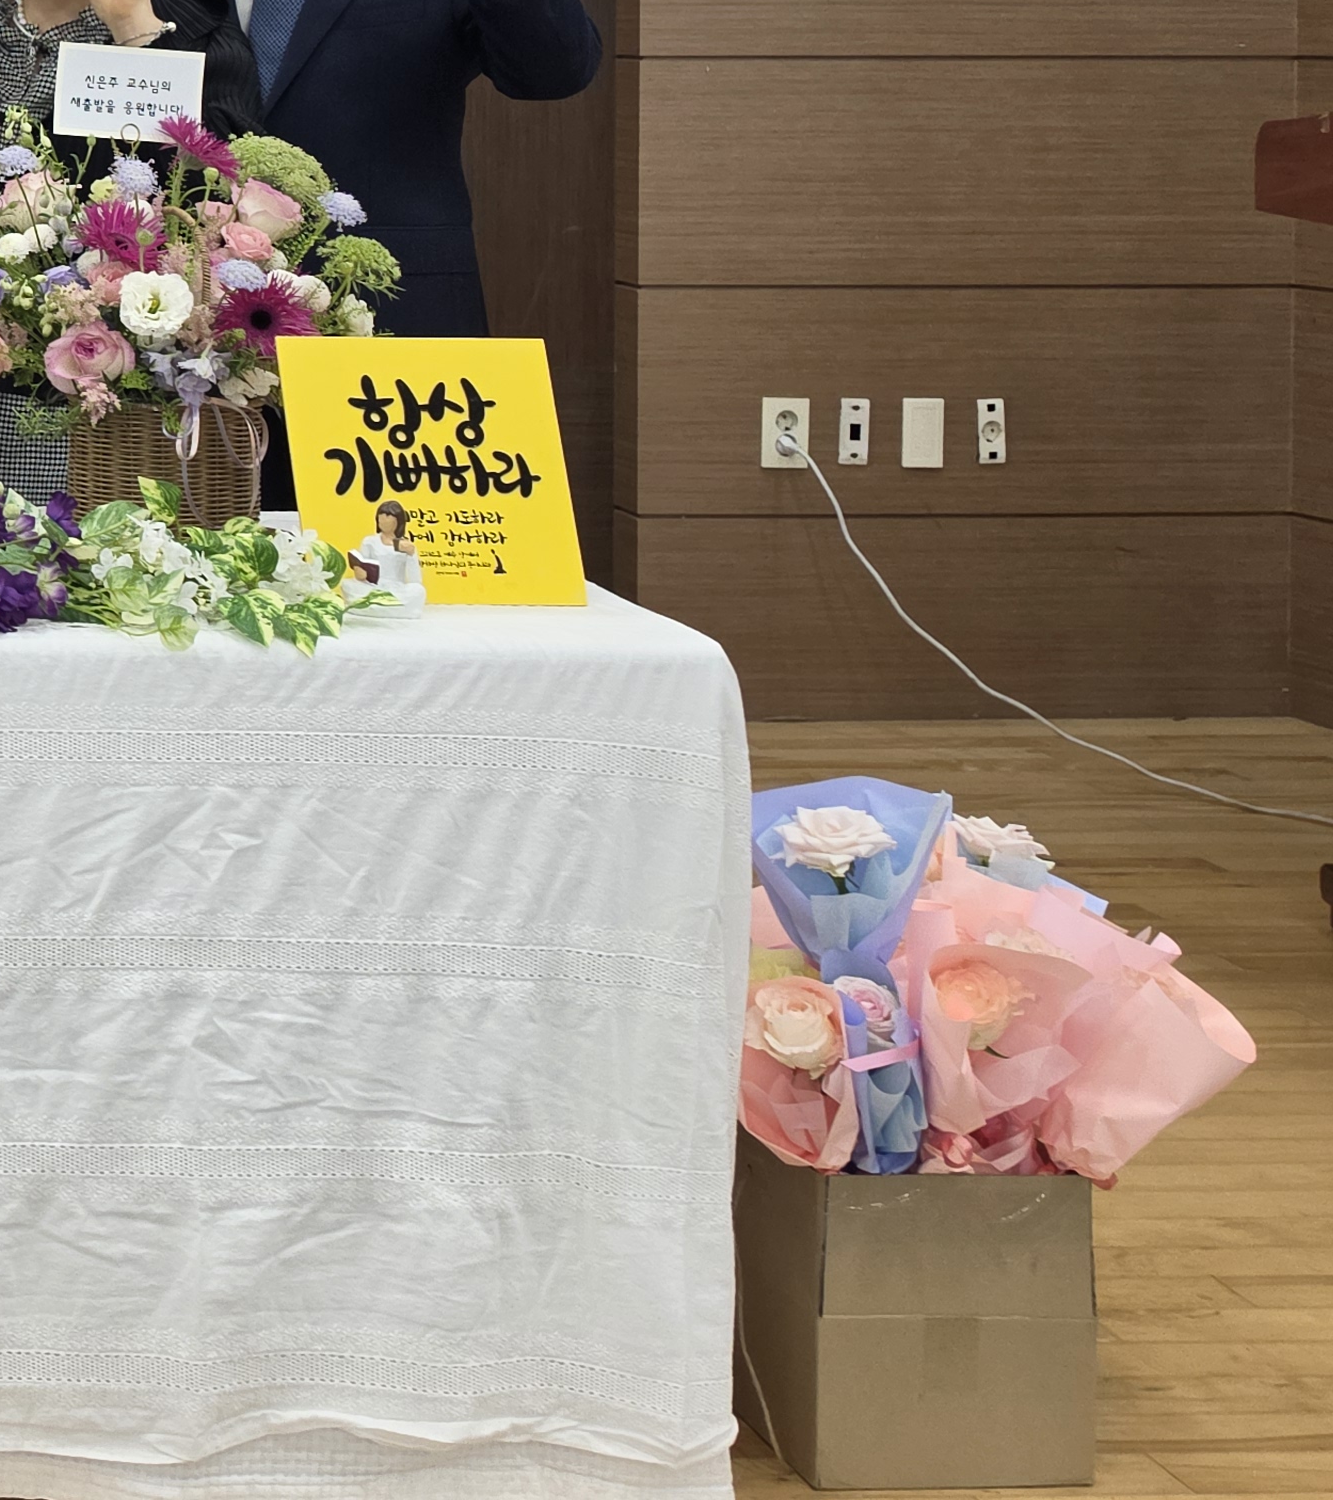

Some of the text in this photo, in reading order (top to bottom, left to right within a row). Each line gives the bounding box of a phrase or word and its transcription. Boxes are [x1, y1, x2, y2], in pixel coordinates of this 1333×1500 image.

[85, 74, 172, 94] 신은주 교수님의
[70, 97, 116, 114] 새출발을
[347, 374, 497, 449] 항상
[323, 436, 542, 502] 기뻐하라
[445, 508, 505, 525] 기도하라
